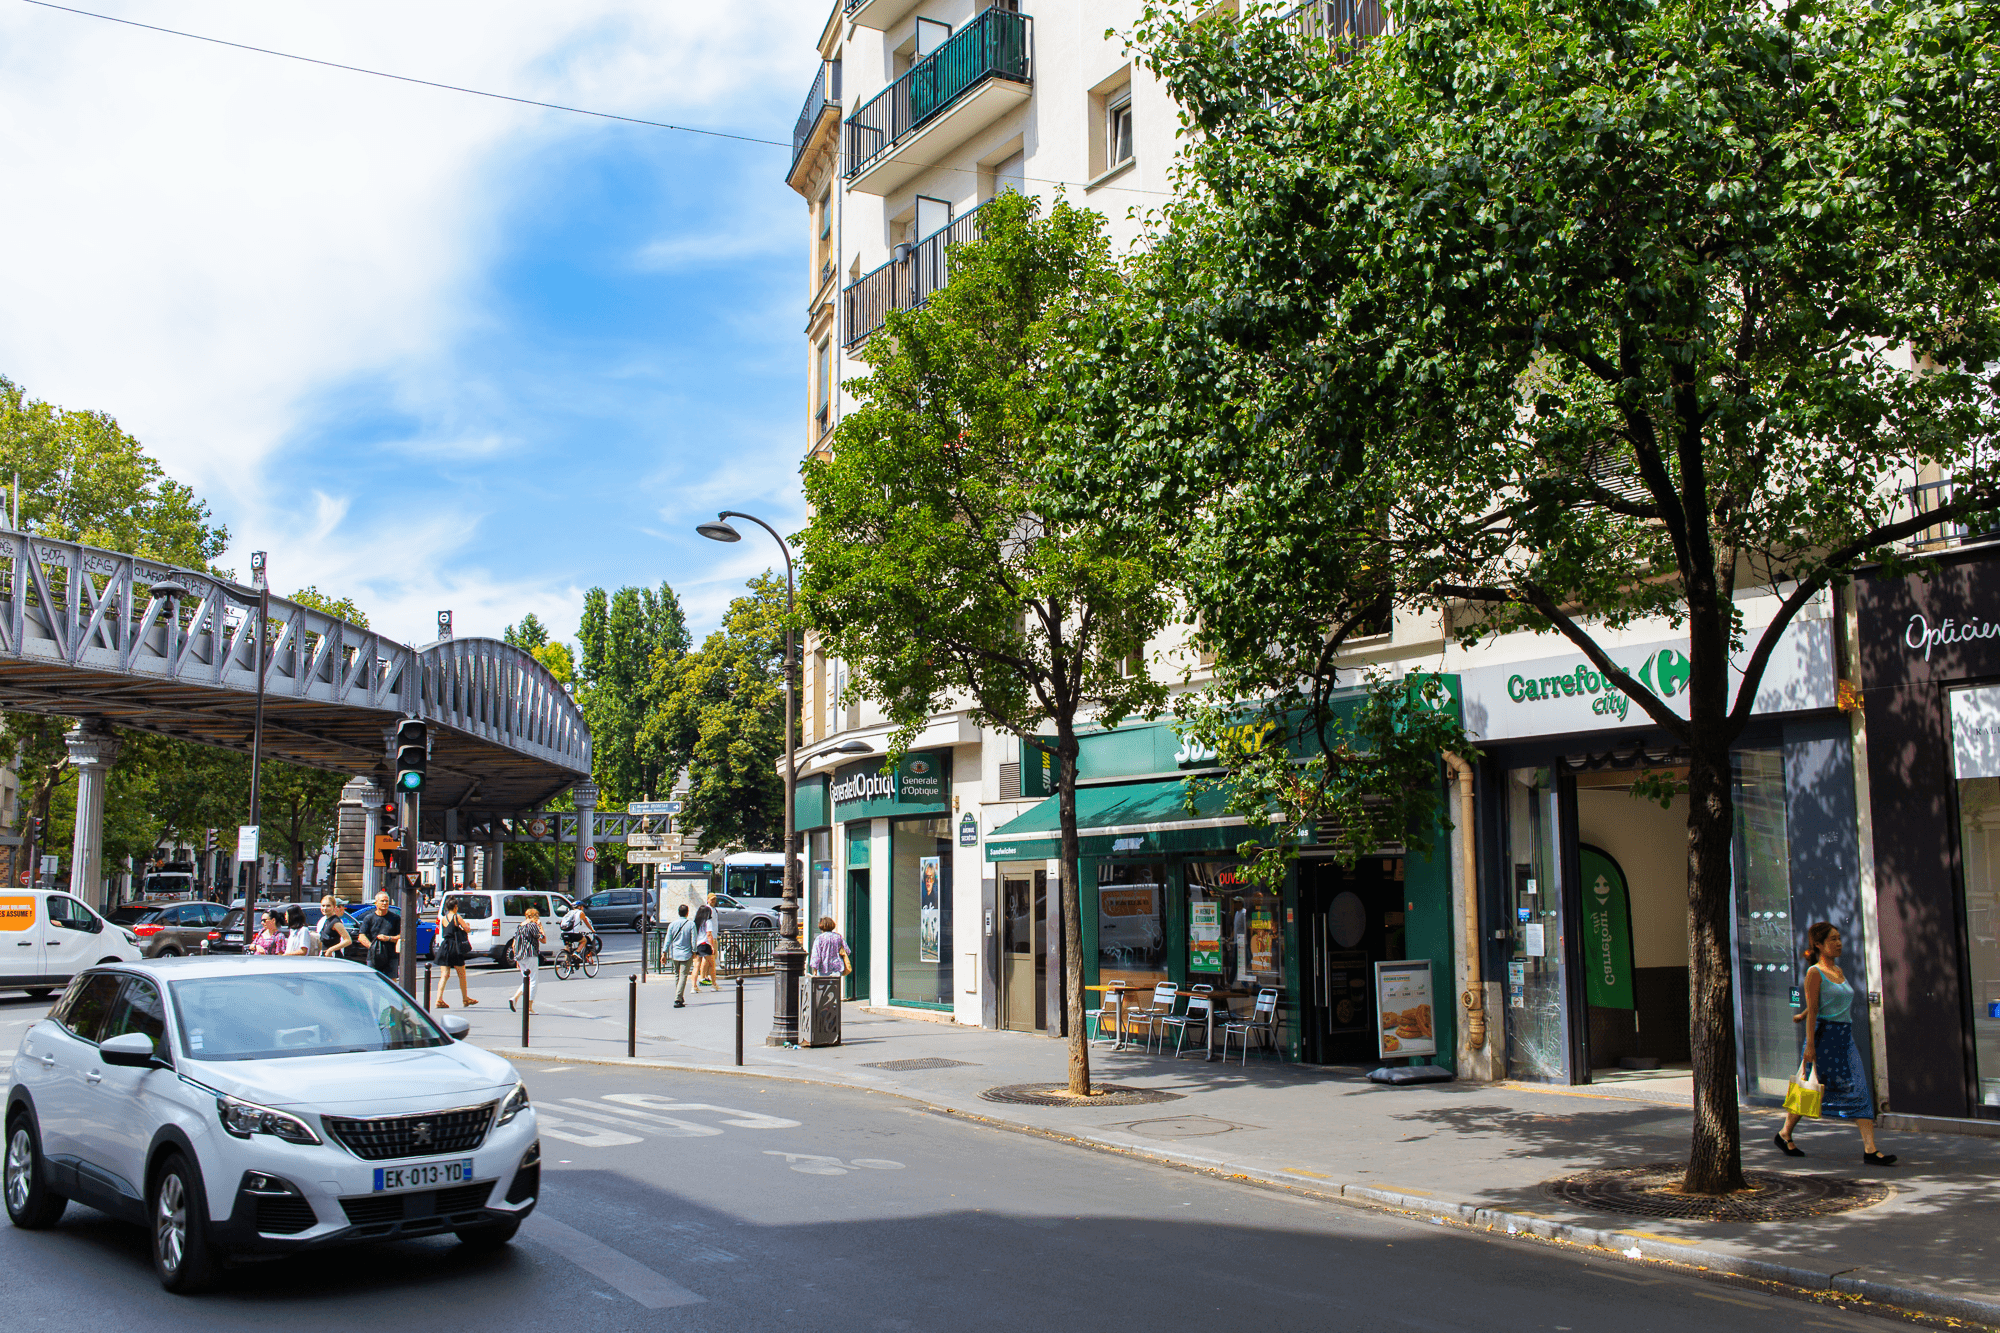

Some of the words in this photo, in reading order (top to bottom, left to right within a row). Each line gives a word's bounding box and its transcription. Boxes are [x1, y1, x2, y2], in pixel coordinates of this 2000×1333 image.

[1507, 664, 1630, 702] Carrefou
[1592, 691, 1630, 721] city
[1041, 739, 1051, 793] SUBWA
[902, 775, 938, 785] Generale
[901, 786, 939, 796] d'Optique
[990, 847, 1017, 856] Sandwiches
[1219, 872, 1249, 885] OUVE
[385, 1163, 462, 1188] EK-013-YD
